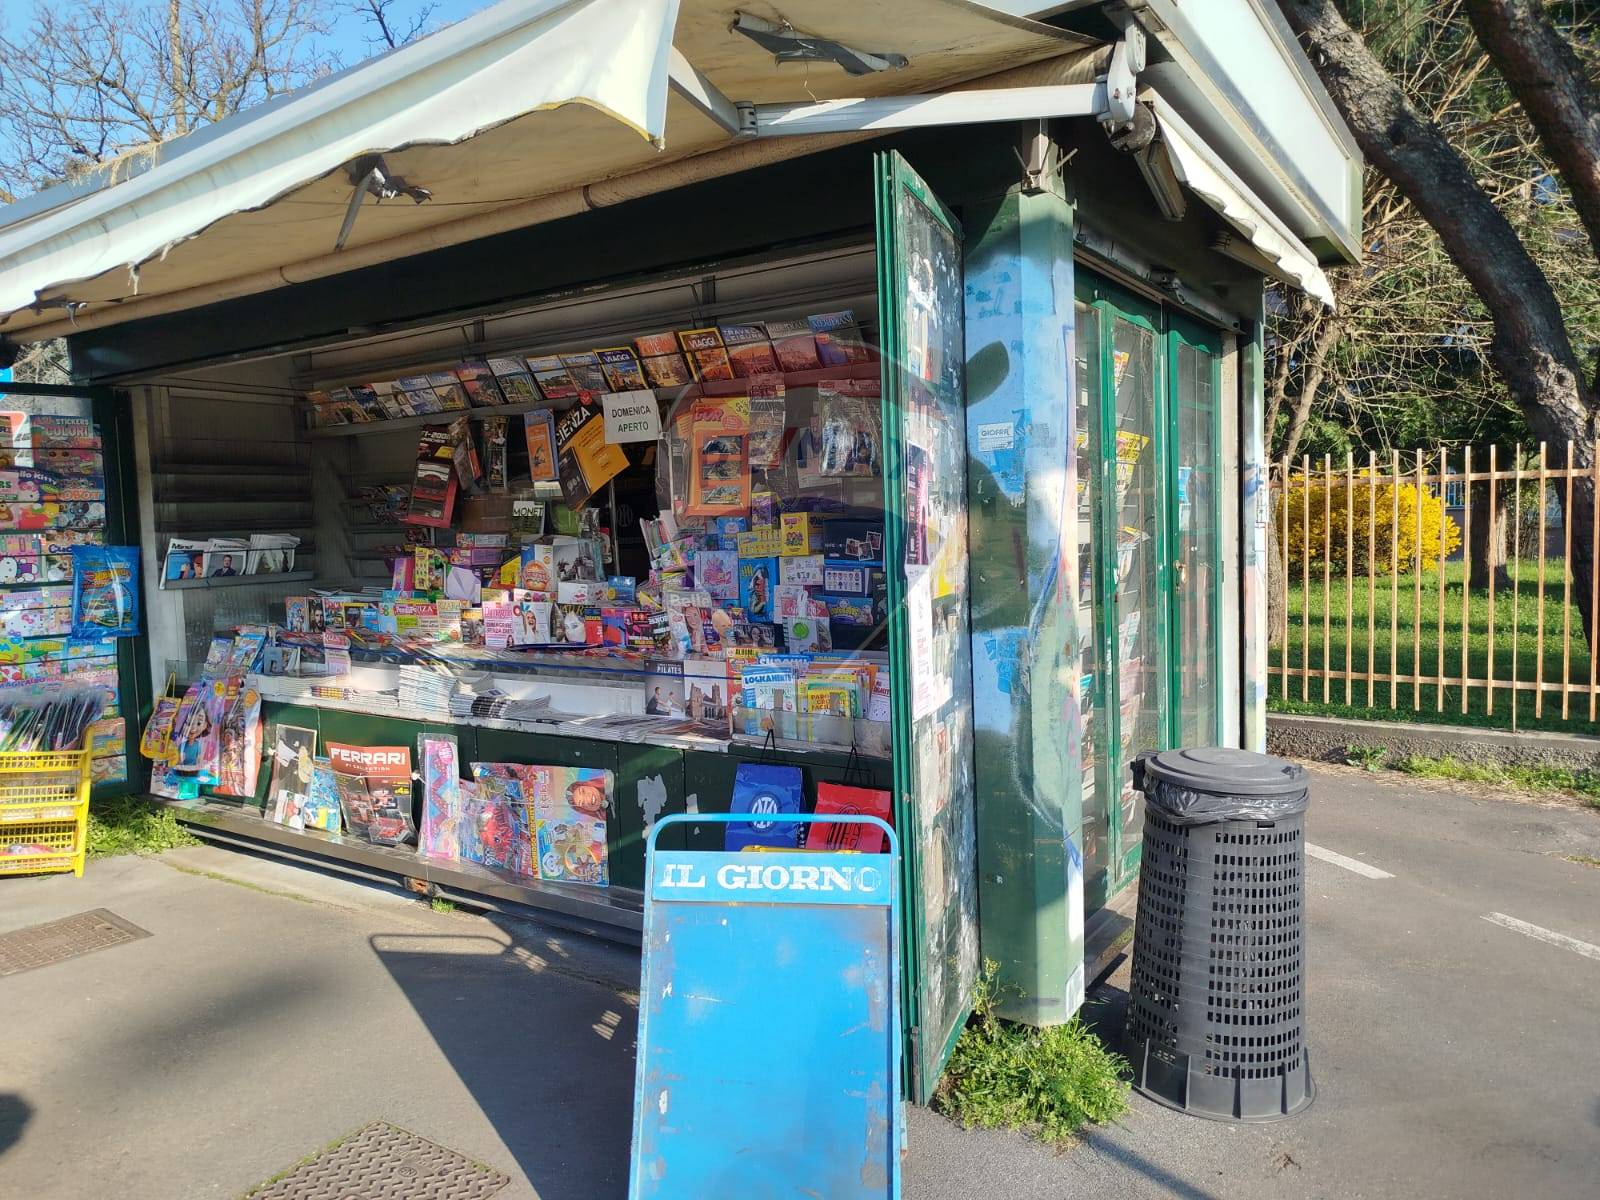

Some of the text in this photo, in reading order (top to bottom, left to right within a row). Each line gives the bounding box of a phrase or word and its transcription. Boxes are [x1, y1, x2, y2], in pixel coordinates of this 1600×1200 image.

[688, 337, 716, 348] VIAGGI
[603, 353, 630, 362] VIAGGI
[612, 404, 651, 418] DOMENICA
[618, 421, 649, 433] APERTO
[513, 507, 543, 516] MONET
[657, 665, 682, 674] PILATES
[330, 747, 406, 765] FERRARI
[661, 863, 882, 893] IL GIORNO
